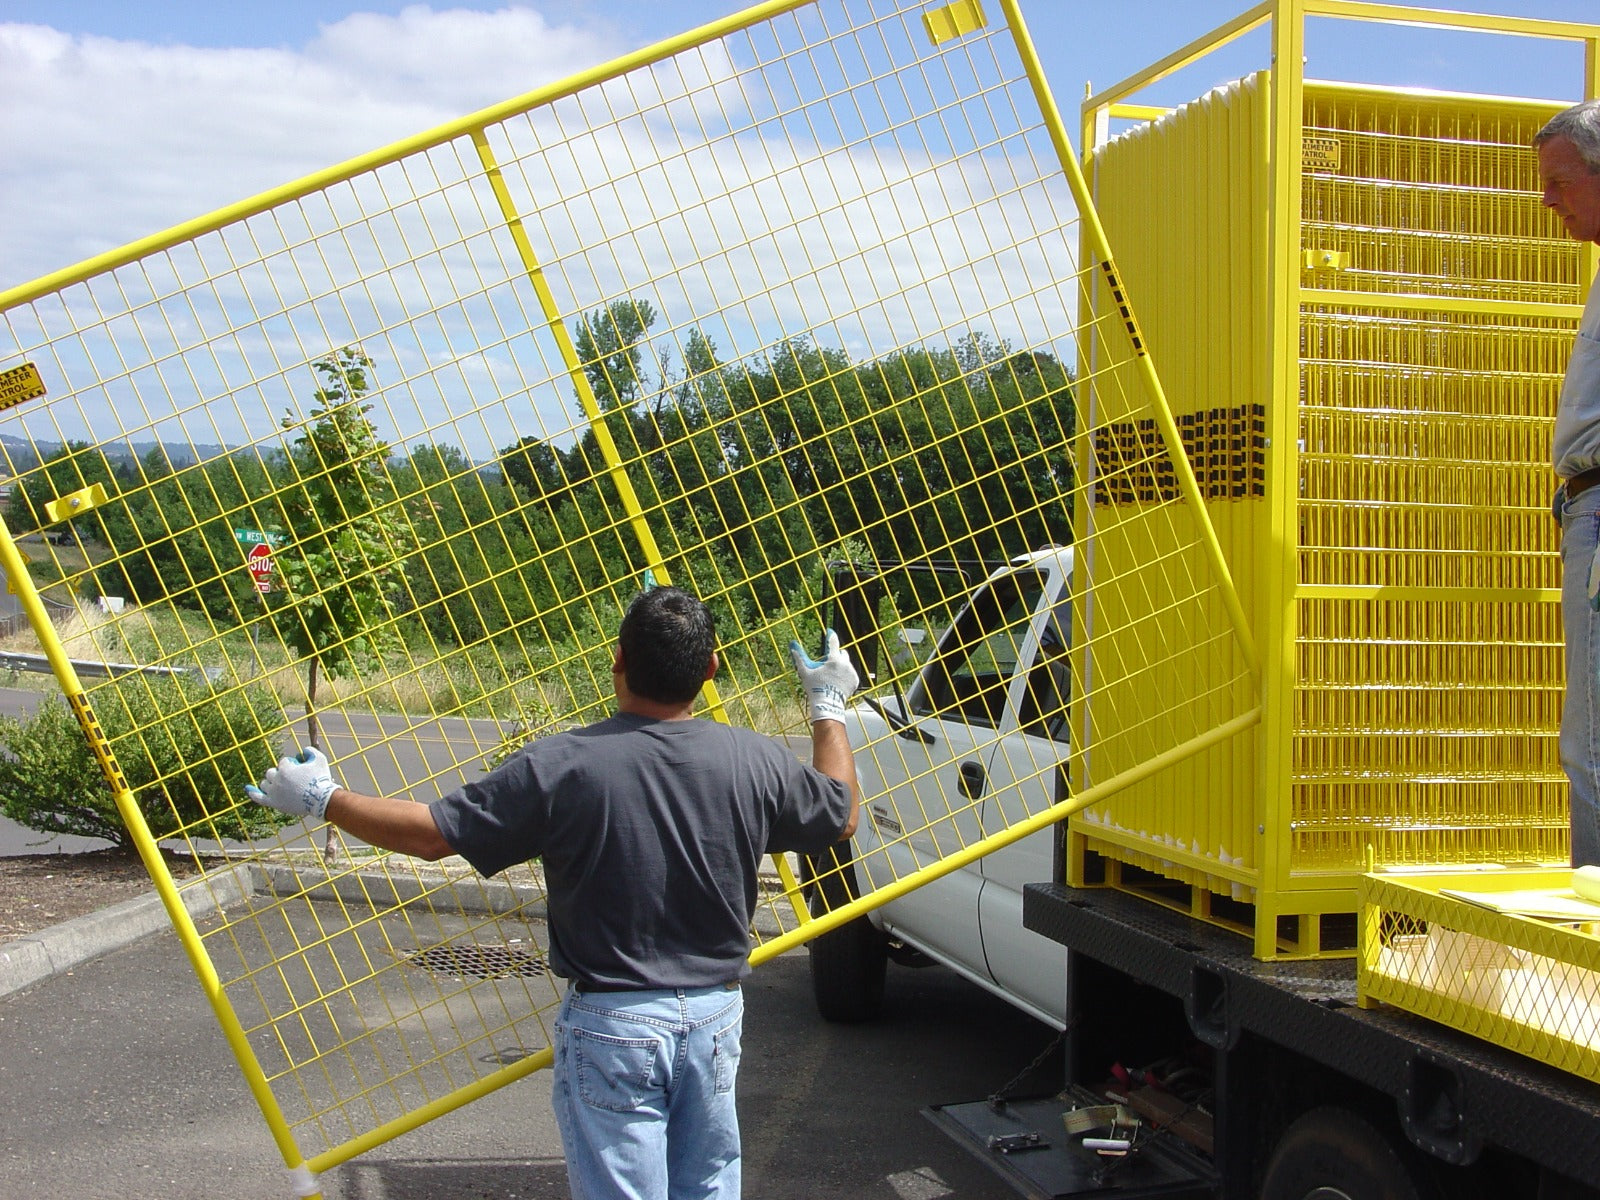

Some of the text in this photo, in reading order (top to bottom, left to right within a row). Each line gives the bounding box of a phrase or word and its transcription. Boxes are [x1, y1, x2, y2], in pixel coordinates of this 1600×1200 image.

[0, 371, 32, 389] METER
[246, 531, 262, 542] WEST
[250, 555, 275, 572] STOP
